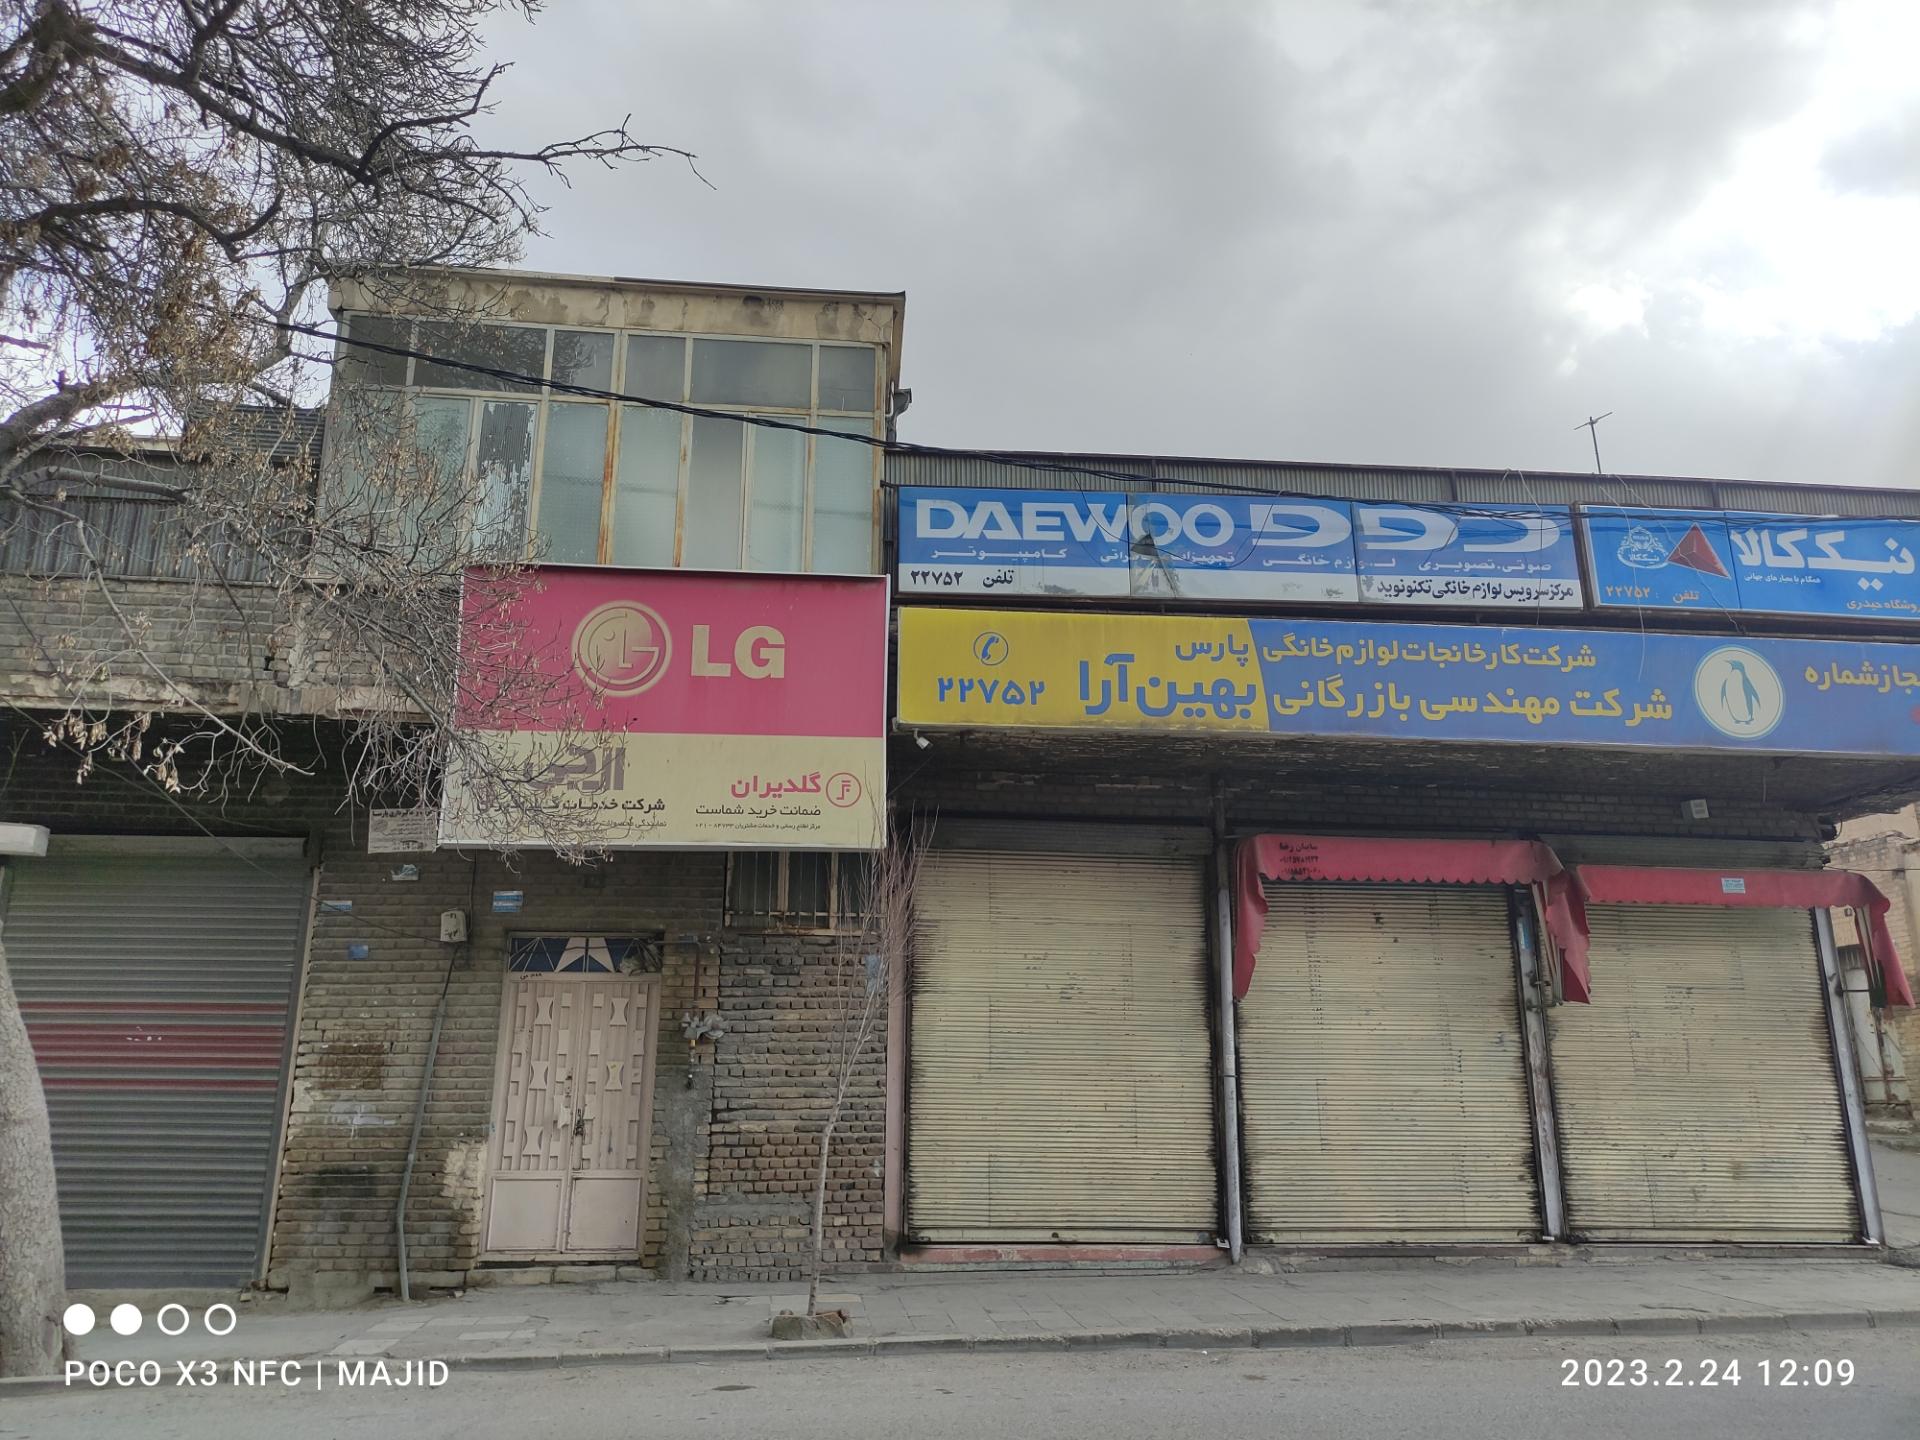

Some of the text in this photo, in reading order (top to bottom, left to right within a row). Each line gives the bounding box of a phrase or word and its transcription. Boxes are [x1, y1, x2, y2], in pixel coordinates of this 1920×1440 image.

[916, 499, 1235, 547] DAEWOO
[930, 547, 1068, 562] کامپیوتر
[1262, 553, 1331, 569] خانگی
[1731, 527, 1915, 592] نیک کالا
[910, 569, 1014, 589] تلفن ۲۲۷۵۲
[1432, 580, 1471, 599] خانگی
[1472, 582, 1502, 600] لوازم
[1504, 583, 1551, 603] سرویس
[1549, 583, 1574, 601] مرکز
[1606, 585, 1699, 604] تلفن ۲۲۷۵۲
[1883, 598, 1920, 613] روشگاه
[690, 624, 786, 680] LG
[1175, 632, 1597, 674] شرکت کارخانجات لوازم خانگی پارس
[1804, 660, 1920, 695] جاز شماره
[937, 677, 1046, 705] ۲۲۷۵۲
[1078, 653, 1673, 727] شرکت مهندسی بازرگانی بهین آرا
[730, 771, 822, 799] گلدیران
[562, 798, 619, 812] خدمات
[621, 798, 666, 814] شرکت
[695, 803, 822, 819] ضمانت خرید شماست
